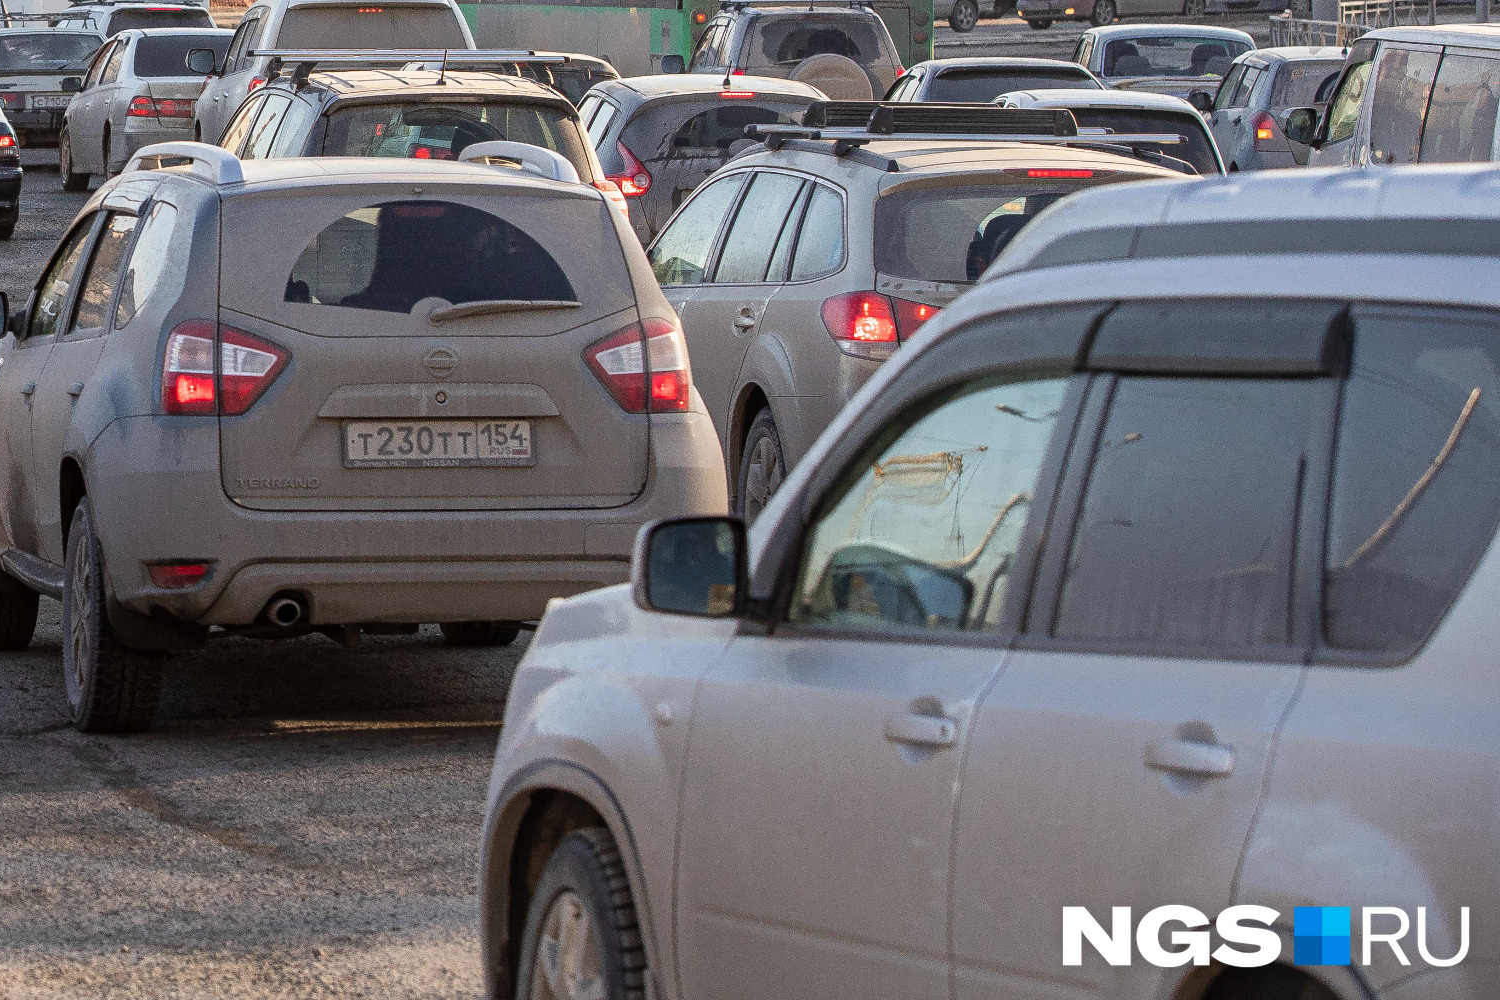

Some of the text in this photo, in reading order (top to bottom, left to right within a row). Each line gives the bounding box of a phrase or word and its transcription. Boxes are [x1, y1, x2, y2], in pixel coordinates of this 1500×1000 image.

[357, 423, 524, 456] Т230ТТ 154
[490, 447, 512, 455] RUS
[235, 477, 320, 489] TERRANO
